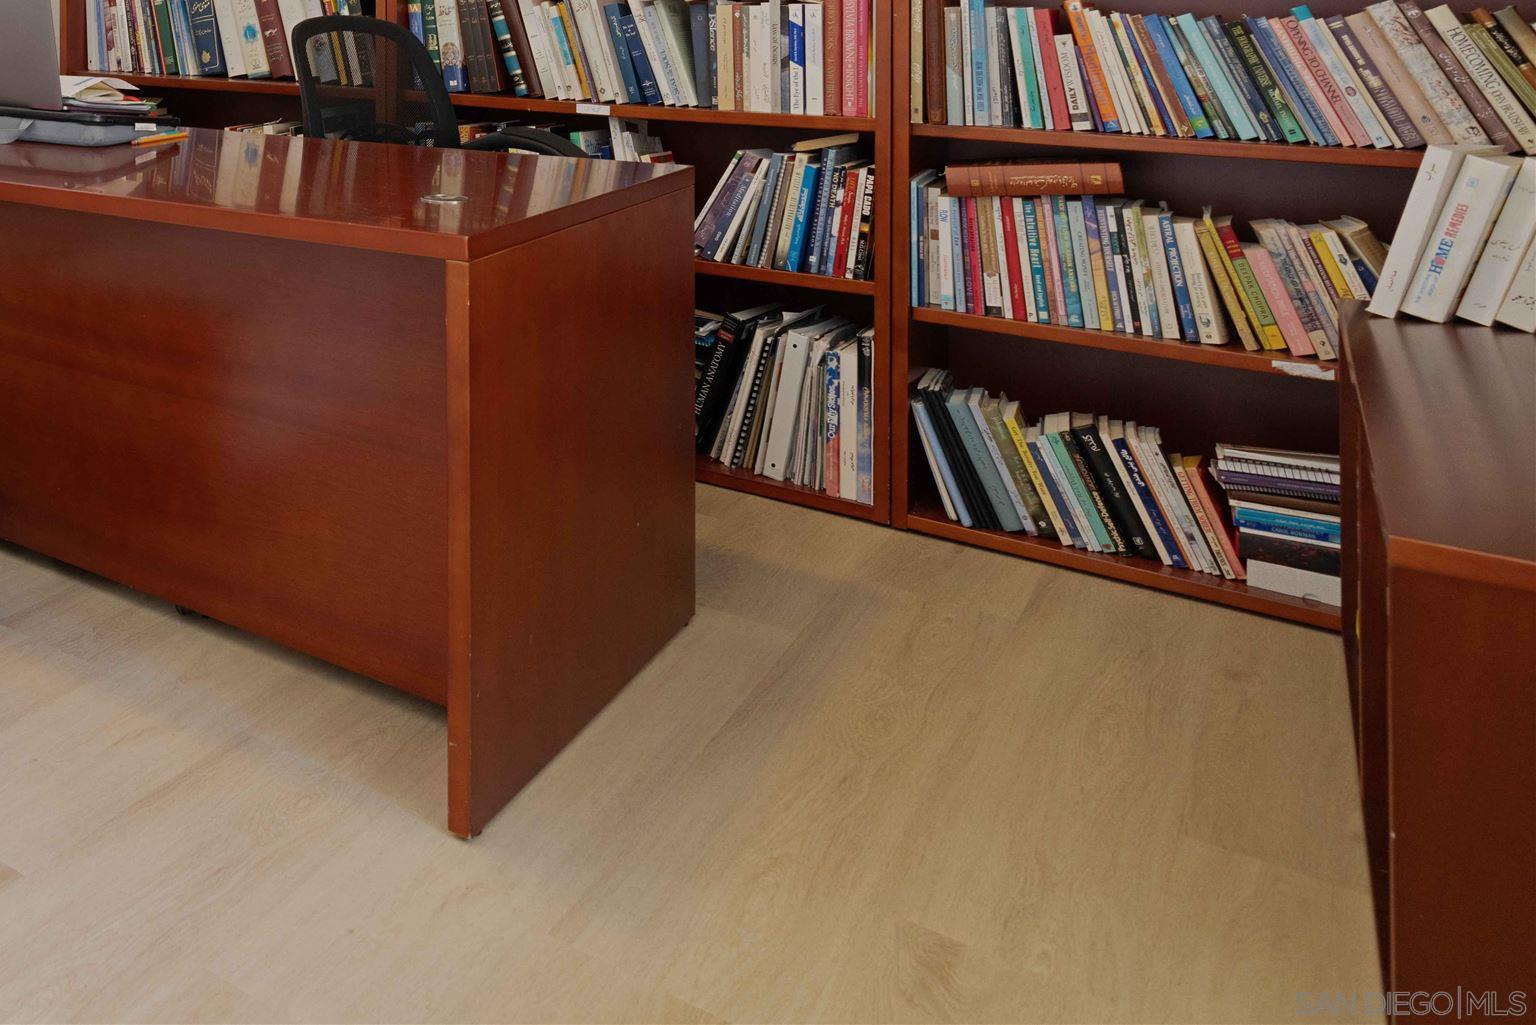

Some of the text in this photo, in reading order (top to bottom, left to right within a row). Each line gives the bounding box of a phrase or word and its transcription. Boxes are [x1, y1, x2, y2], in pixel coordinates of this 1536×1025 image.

[844, 0, 856, 101] SYLVIA BROWNE INSIGHT
[1284, 17, 1343, 106] OPENING TO CHANNEL
[1445, 23, 1502, 94] HOMECOMING
[1064, 85, 1081, 111] DAILY
[831, 170, 841, 186] NO
[1025, 214, 1040, 246] Intuitive
[1444, 202, 1470, 239] REMEDIES
[1030, 248, 1043, 269] Heart
[1160, 218, 1184, 289] ASTRAL PROJECTION
[1236, 260, 1271, 322] DEEPAK CHOPRA
[704, 340, 727, 384] ANATOMY
[1175, 469, 1195, 497] GETTING
